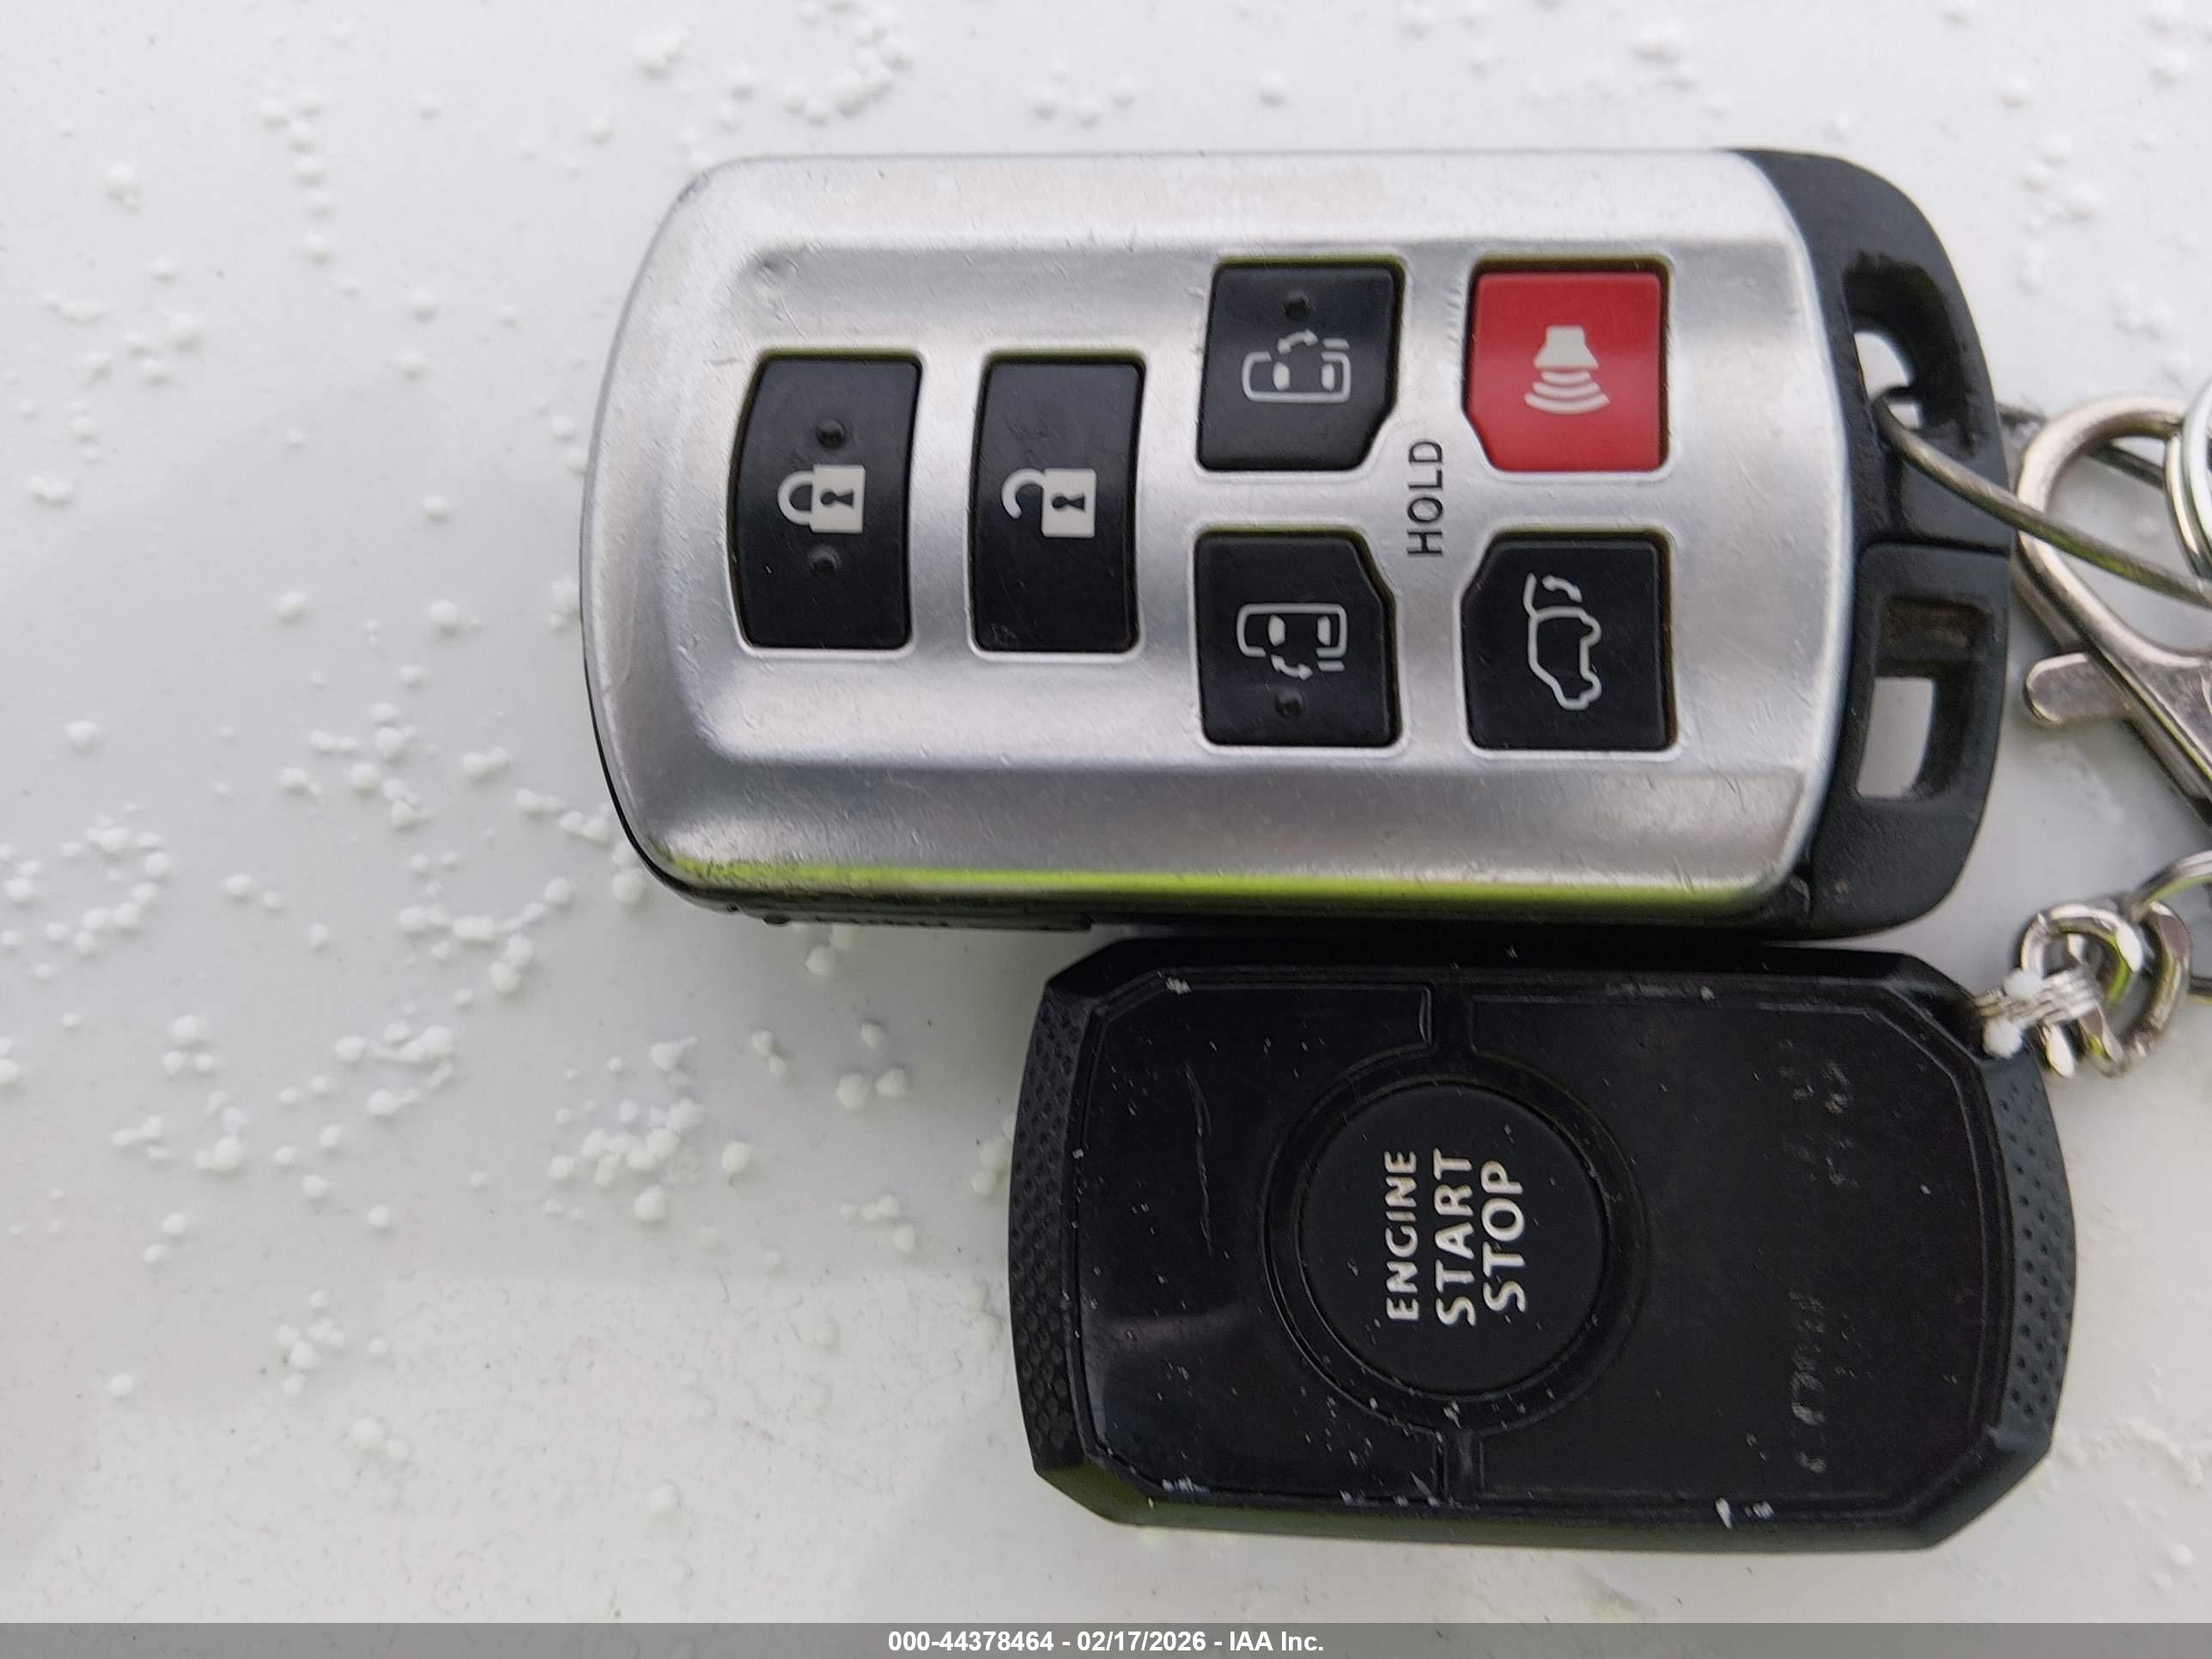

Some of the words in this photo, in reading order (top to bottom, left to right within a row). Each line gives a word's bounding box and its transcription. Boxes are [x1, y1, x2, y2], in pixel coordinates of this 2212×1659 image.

[1407, 441, 1443, 556] HOLD
[1384, 1150, 1419, 1321] ENGINE
[1433, 1147, 1476, 1326] START
[1480, 1161, 1526, 1313] STOP
